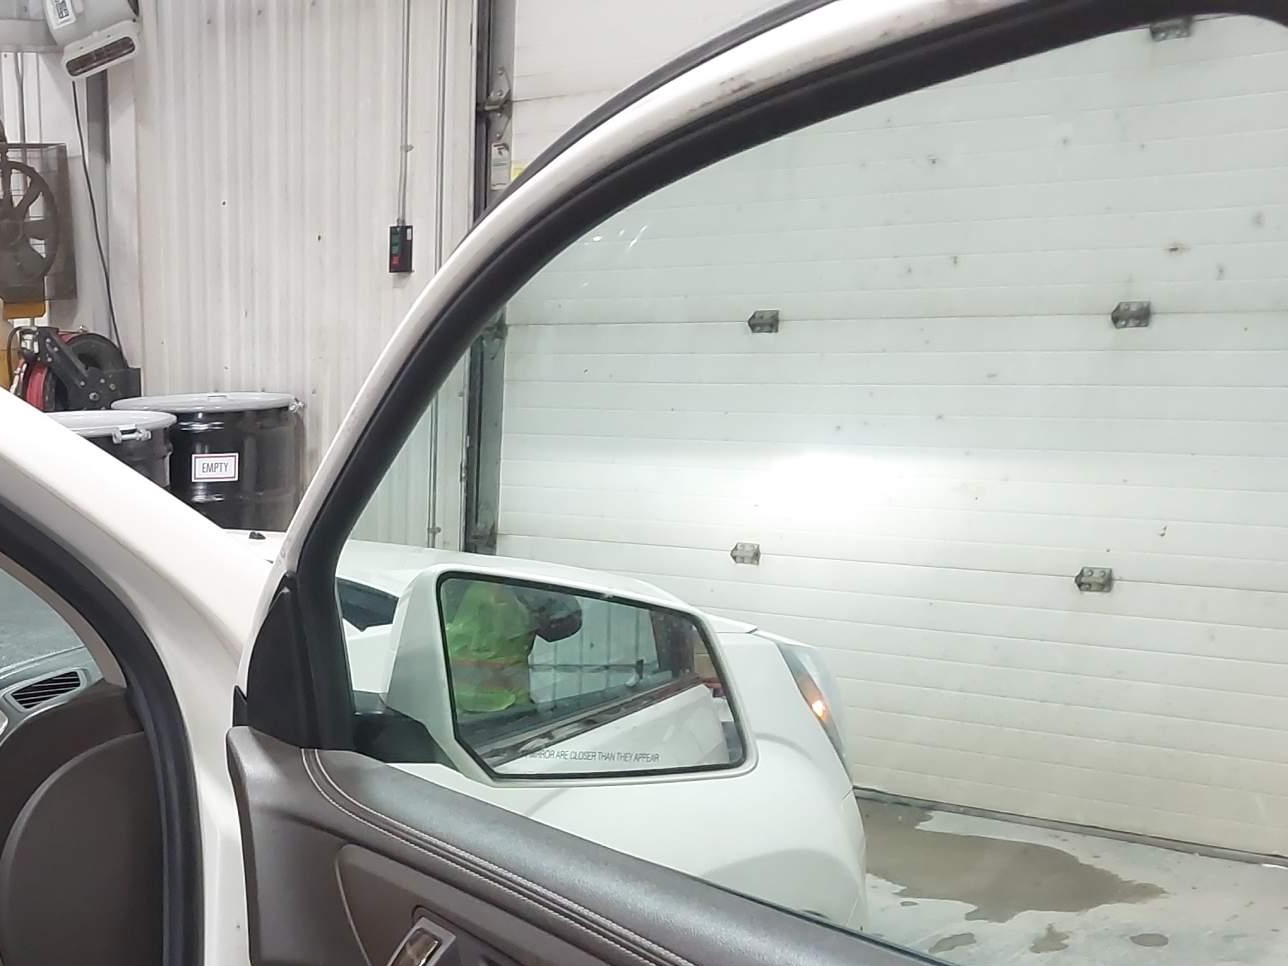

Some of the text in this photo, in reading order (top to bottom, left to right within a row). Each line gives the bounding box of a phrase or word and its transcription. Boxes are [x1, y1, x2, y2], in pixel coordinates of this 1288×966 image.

[202, 462, 229, 473] EMPTY
[556, 750, 569, 760] ARE
[571, 750, 596, 761] CLOSER
[598, 751, 615, 761] THAN
[616, 752, 633, 762] THEY
[632, 752, 660, 763] APPEAR
